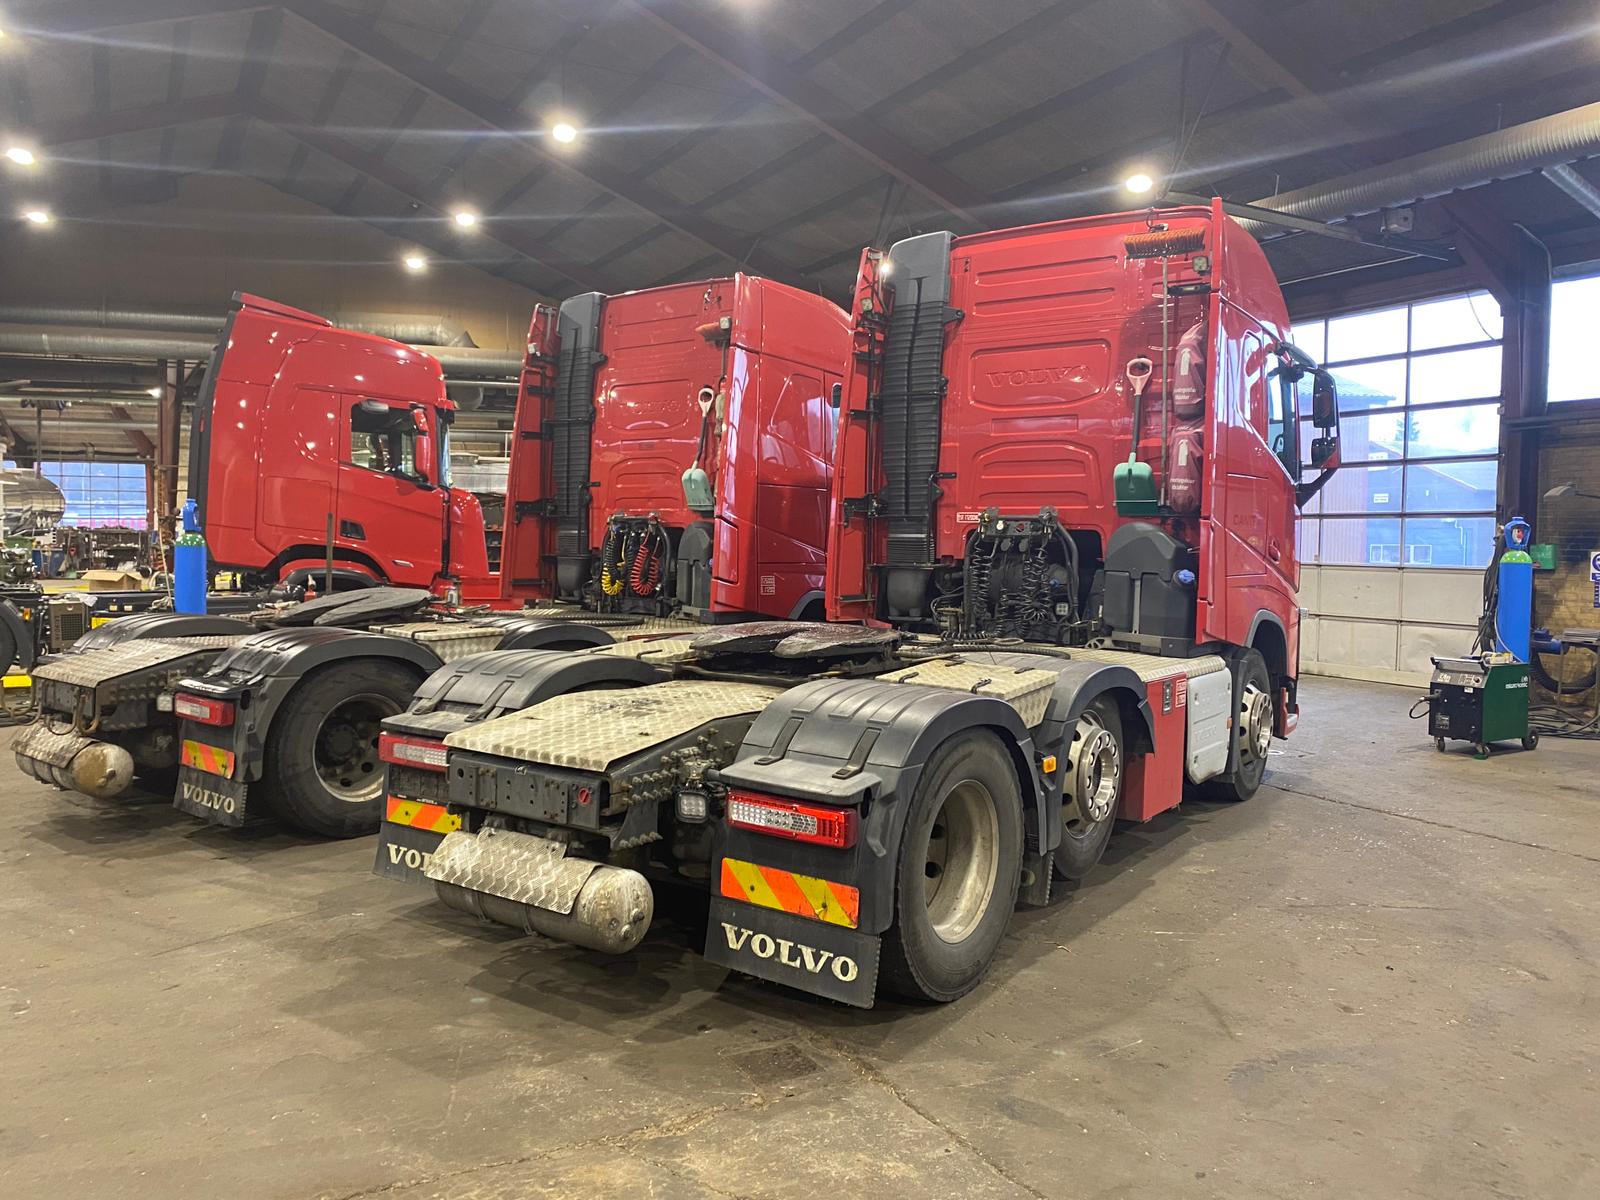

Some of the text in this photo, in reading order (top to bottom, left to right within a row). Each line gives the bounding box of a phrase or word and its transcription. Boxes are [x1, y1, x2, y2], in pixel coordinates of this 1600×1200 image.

[985, 364, 1089, 388] VOLVO
[182, 782, 235, 814] VOLVO
[721, 922, 859, 982] VOLVO
